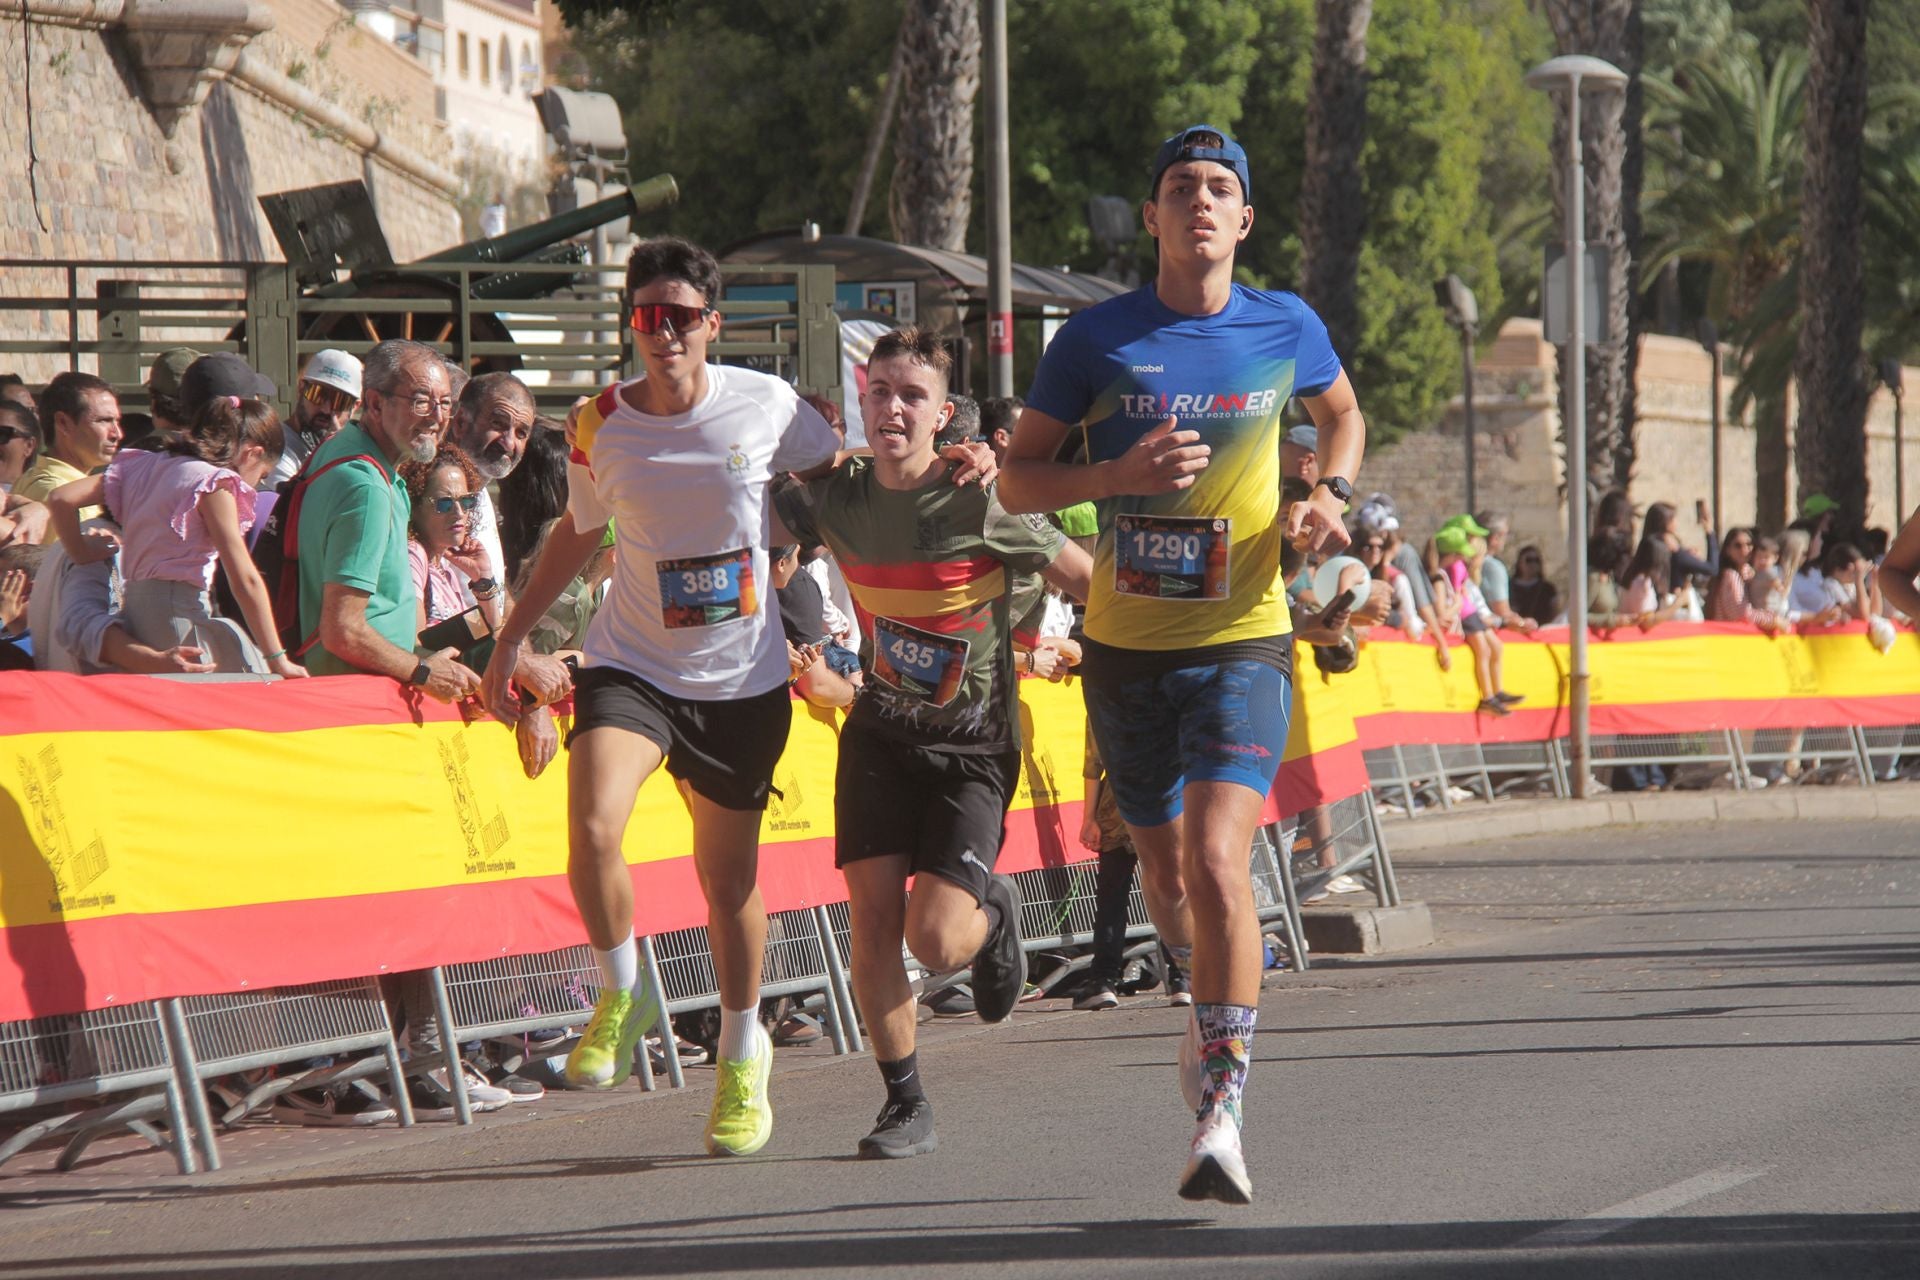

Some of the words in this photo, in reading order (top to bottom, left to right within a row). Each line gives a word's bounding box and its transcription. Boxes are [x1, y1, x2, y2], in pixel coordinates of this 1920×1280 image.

[1132, 364, 1164, 373] mobel
[1133, 531, 1200, 560] 1290
[682, 567, 728, 594] 388
[890, 639, 935, 668] 435
